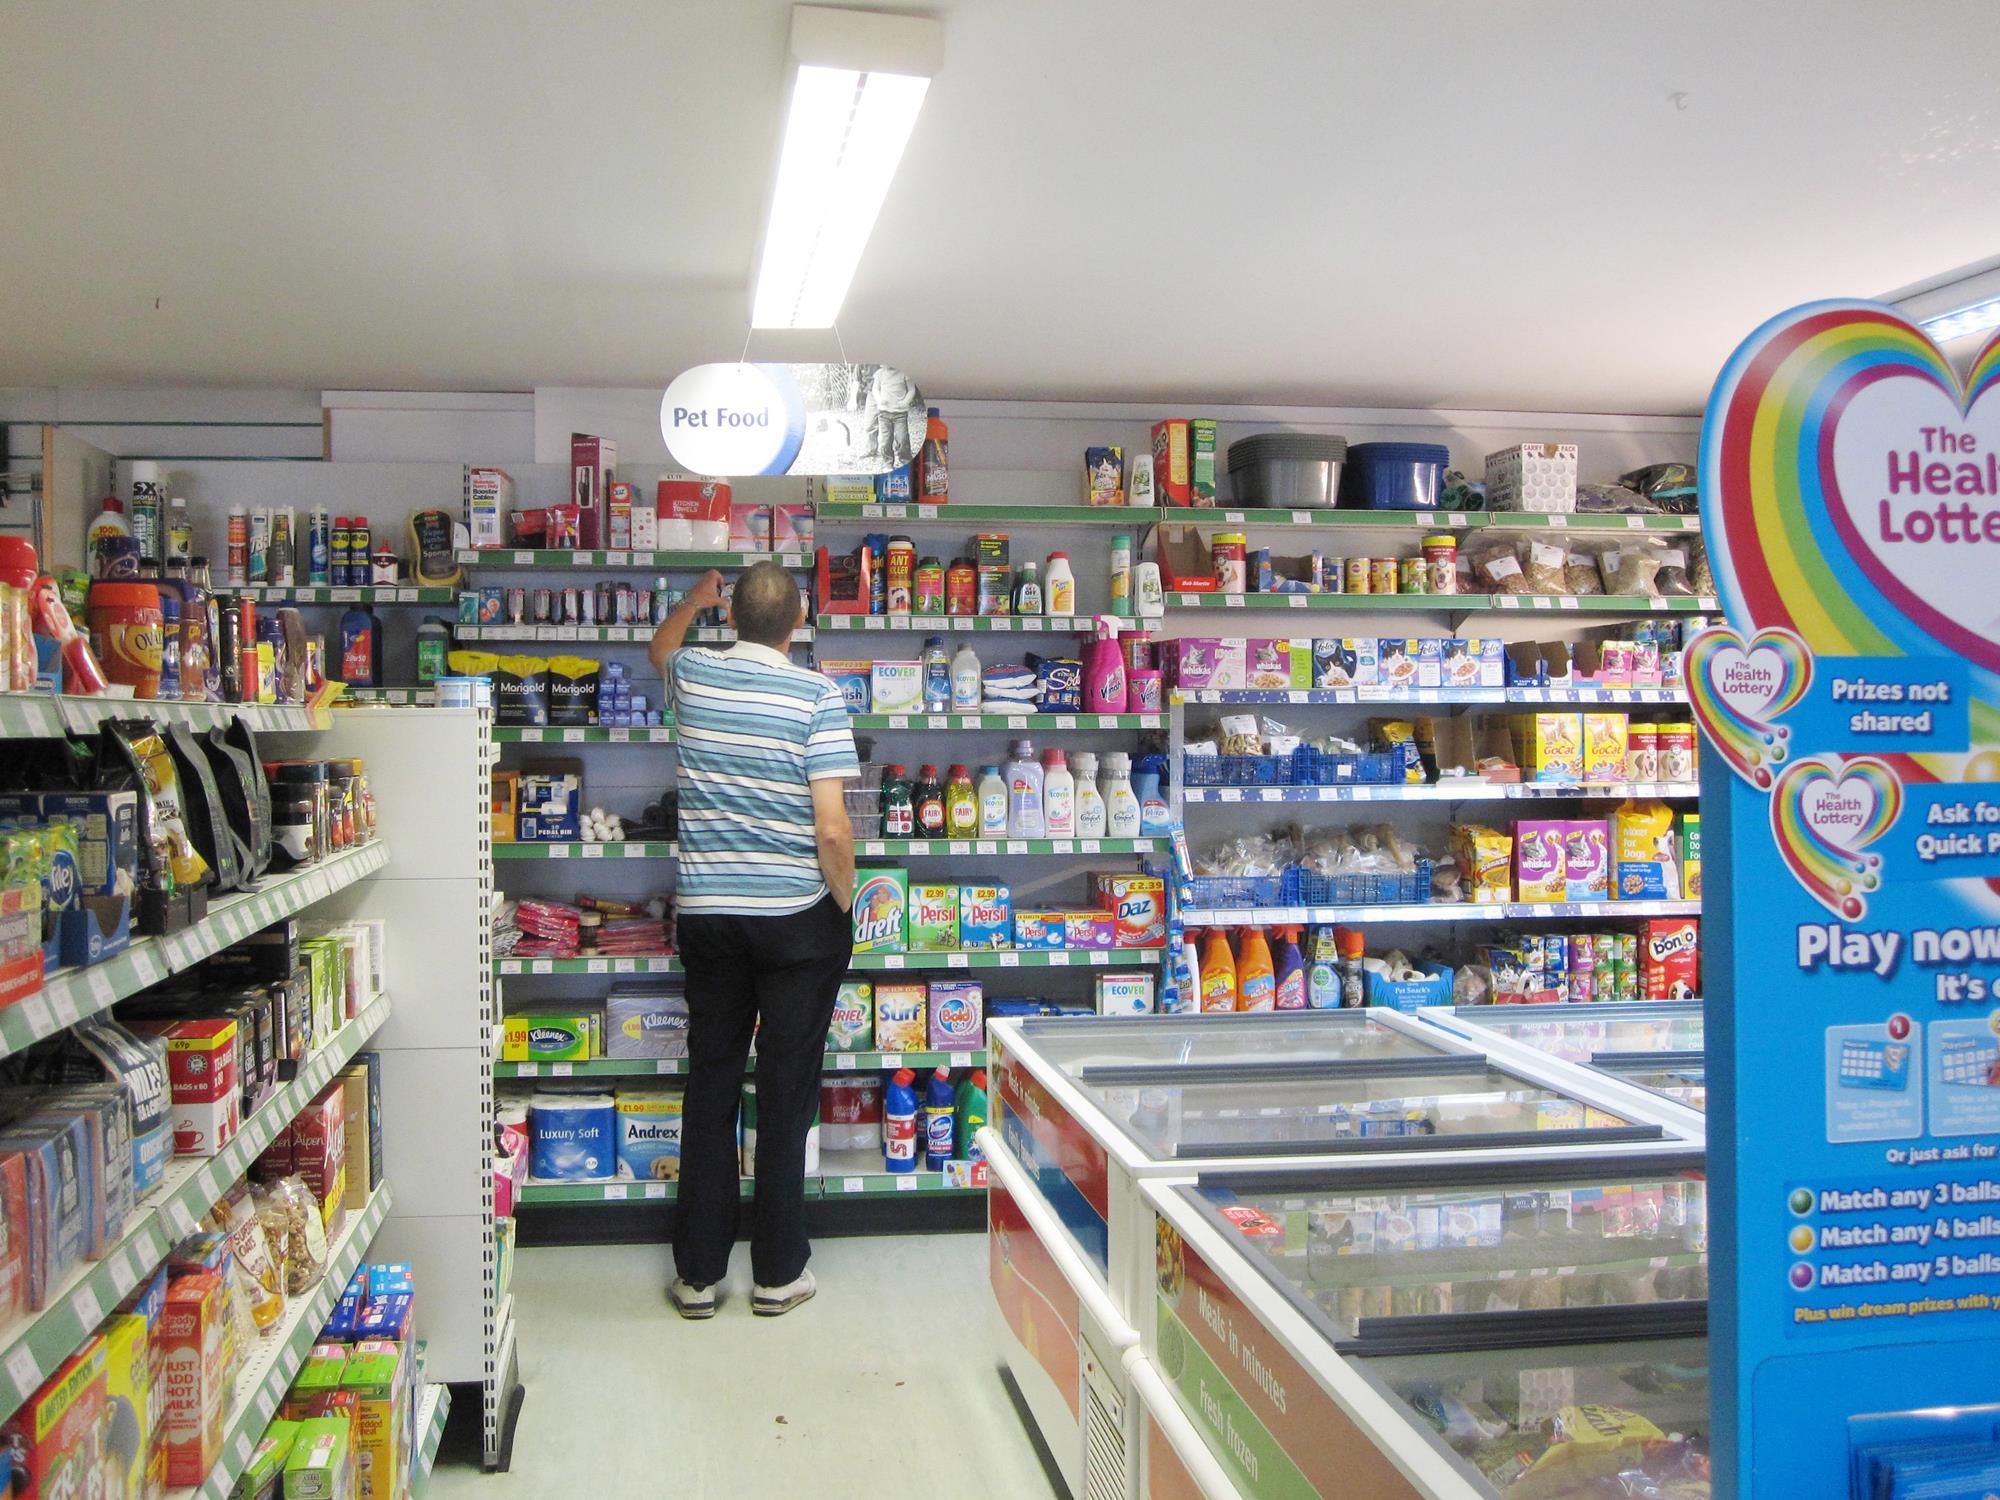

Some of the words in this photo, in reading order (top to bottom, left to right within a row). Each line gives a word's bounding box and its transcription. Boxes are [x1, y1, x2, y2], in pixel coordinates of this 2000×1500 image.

[673, 408, 708, 427] Pet
[717, 407, 769, 427] Food
[1919, 427, 1976, 453] The
[1888, 450, 1998, 495] Heal
[1879, 499, 2000, 543] Lotte
[891, 556, 909, 565] ANT
[879, 667, 916, 677] ECOVER
[1735, 661, 1750, 669] The
[1725, 668, 1771, 681] Health
[501, 682, 545, 695] Marigold
[552, 683, 595, 696] Marigold
[1722, 681, 1773, 697] Lottery
[1832, 678, 1903, 701] Prizes
[1908, 681, 1949, 701] not
[1850, 710, 1931, 732] shared
[1825, 792, 1840, 800] The
[1816, 799, 1861, 811] Health
[1927, 803, 1970, 823] Ask
[1974, 802, 2000, 822] fo
[1813, 812, 1863, 826] Lottery
[1916, 833, 1982, 860] Quick
[1522, 859, 1552, 869] whiskas
[1568, 859, 1595, 869] whiskas
[926, 889, 944, 898] £2.99
[978, 889, 995, 898] £2.99
[921, 905, 956, 926] Persil
[972, 905, 1007, 926] Persil
[1118, 900, 1151, 919] Daz
[854, 905, 903, 943] dreft
[1025, 927, 1046, 939] Persil
[1074, 927, 1096, 939] Persil
[1798, 924, 1900, 976] Play
[1112, 986, 1144, 995] ECOVER
[1936, 973, 1985, 1001] It's
[879, 1003, 922, 1021] Surf
[942, 1008, 971, 1023] Bold
[642, 1012, 688, 1030] Kleenex
[529, 1029, 566, 1042] Kleenex
[175, 1041, 190, 1050] 69p
[295, 1133, 326, 1148] Alpen
[540, 1129, 575, 1140] Luxury
[578, 1128, 599, 1138] Soft
[628, 1125, 679, 1139] Andrex
[1886, 1149, 1905, 1162] Or
[1908, 1148, 1939, 1164] just
[1943, 1145, 1969, 1159] ask
[1974, 1143, 1995, 1157] for
[1820, 1188, 1887, 1211] Match
[1890, 1188, 1931, 1210] any
[1935, 1184, 1948, 1203] 3
[1952, 1181, 2000, 1202] balls
[1820, 1224, 1887, 1248] Match
[1890, 1224, 1931, 1246] any
[1934, 1218, 1948, 1238] 4
[1953, 1216, 2000, 1238] balls
[1820, 1261, 1887, 1285] Match
[1890, 1261, 1931, 1283] any
[1935, 1257, 1948, 1276] 5
[1952, 1254, 2000, 1275] balls
[1795, 1307, 1826, 1323] Plus
[1829, 1305, 1855, 1318] win
[1858, 1302, 1906, 1317] dream
[1909, 1298, 1954, 1315] prizes
[1958, 1294, 1989, 1308] with
[1200, 1286, 1226, 1344] Meals
[1229, 1319, 1239, 1358] in
[1242, 1343, 1287, 1415] minutes
[1200, 1379, 1224, 1436] Fresh
[1227, 1413, 1259, 1482] frozen
